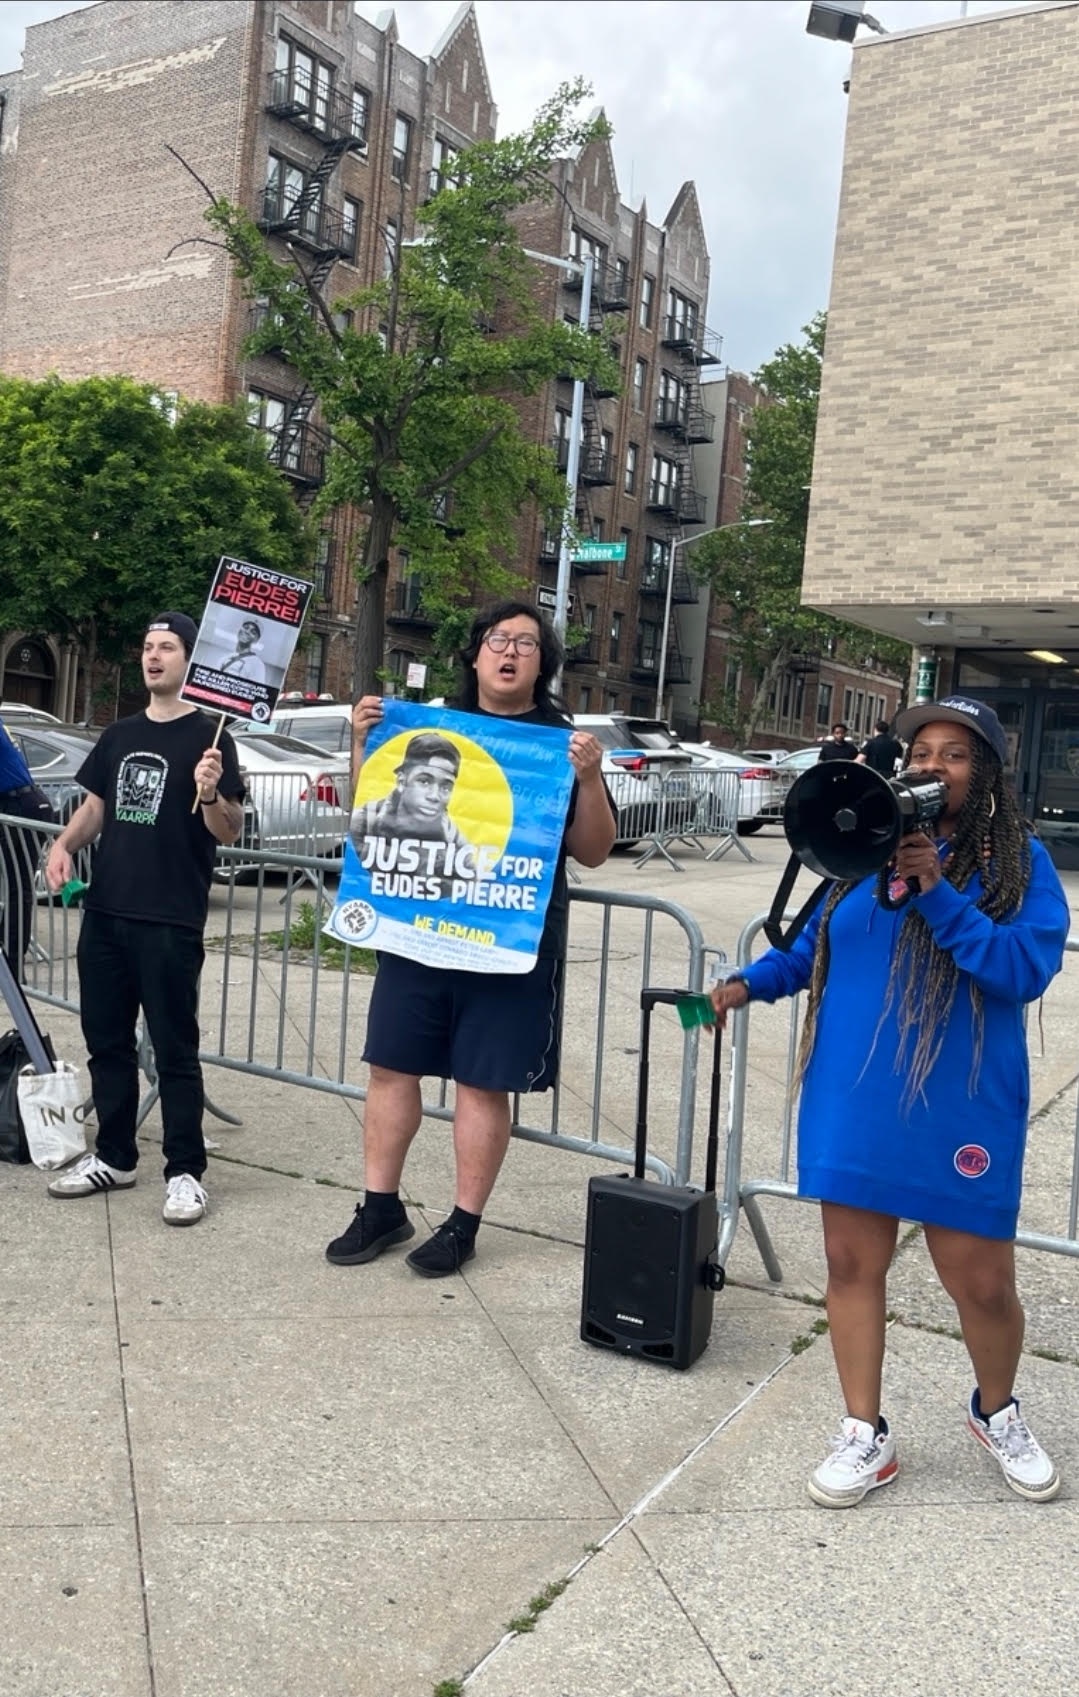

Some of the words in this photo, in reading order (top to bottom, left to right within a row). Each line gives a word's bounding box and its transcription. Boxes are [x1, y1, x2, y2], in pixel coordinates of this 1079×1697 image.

[225, 572, 300, 606] EUDES
[226, 563, 279, 584] JUSTICE
[279, 578, 307, 594] FOR
[214, 585, 300, 623] PIERRE!
[361, 835, 500, 881] JUSTICE
[501, 855, 544, 880] FOR
[371, 871, 442, 901] EUDES
[451, 881, 537, 911] PIERRE
[413, 914, 435, 932] WE
[438, 920, 496, 947] DEMAND
[40, 1106, 65, 1127] IN
